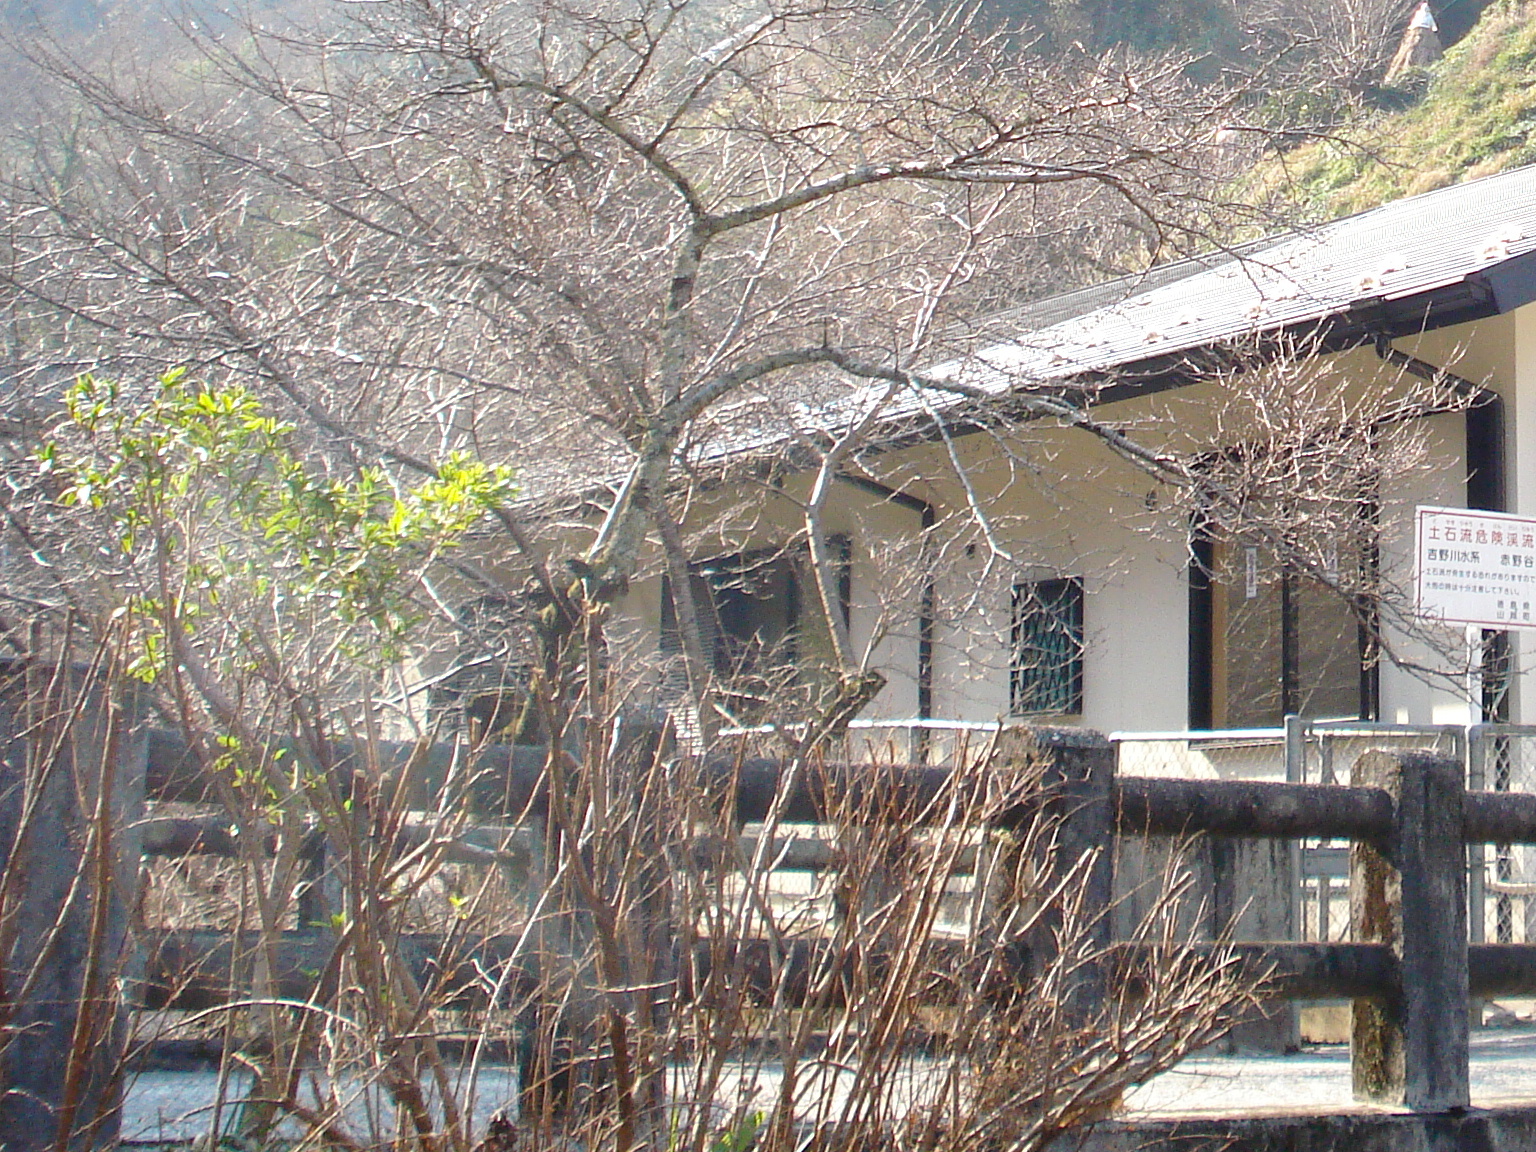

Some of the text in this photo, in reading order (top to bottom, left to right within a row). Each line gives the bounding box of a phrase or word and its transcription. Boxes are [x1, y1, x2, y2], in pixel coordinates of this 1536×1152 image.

[1428, 549, 1480, 563] 吉野川水系
